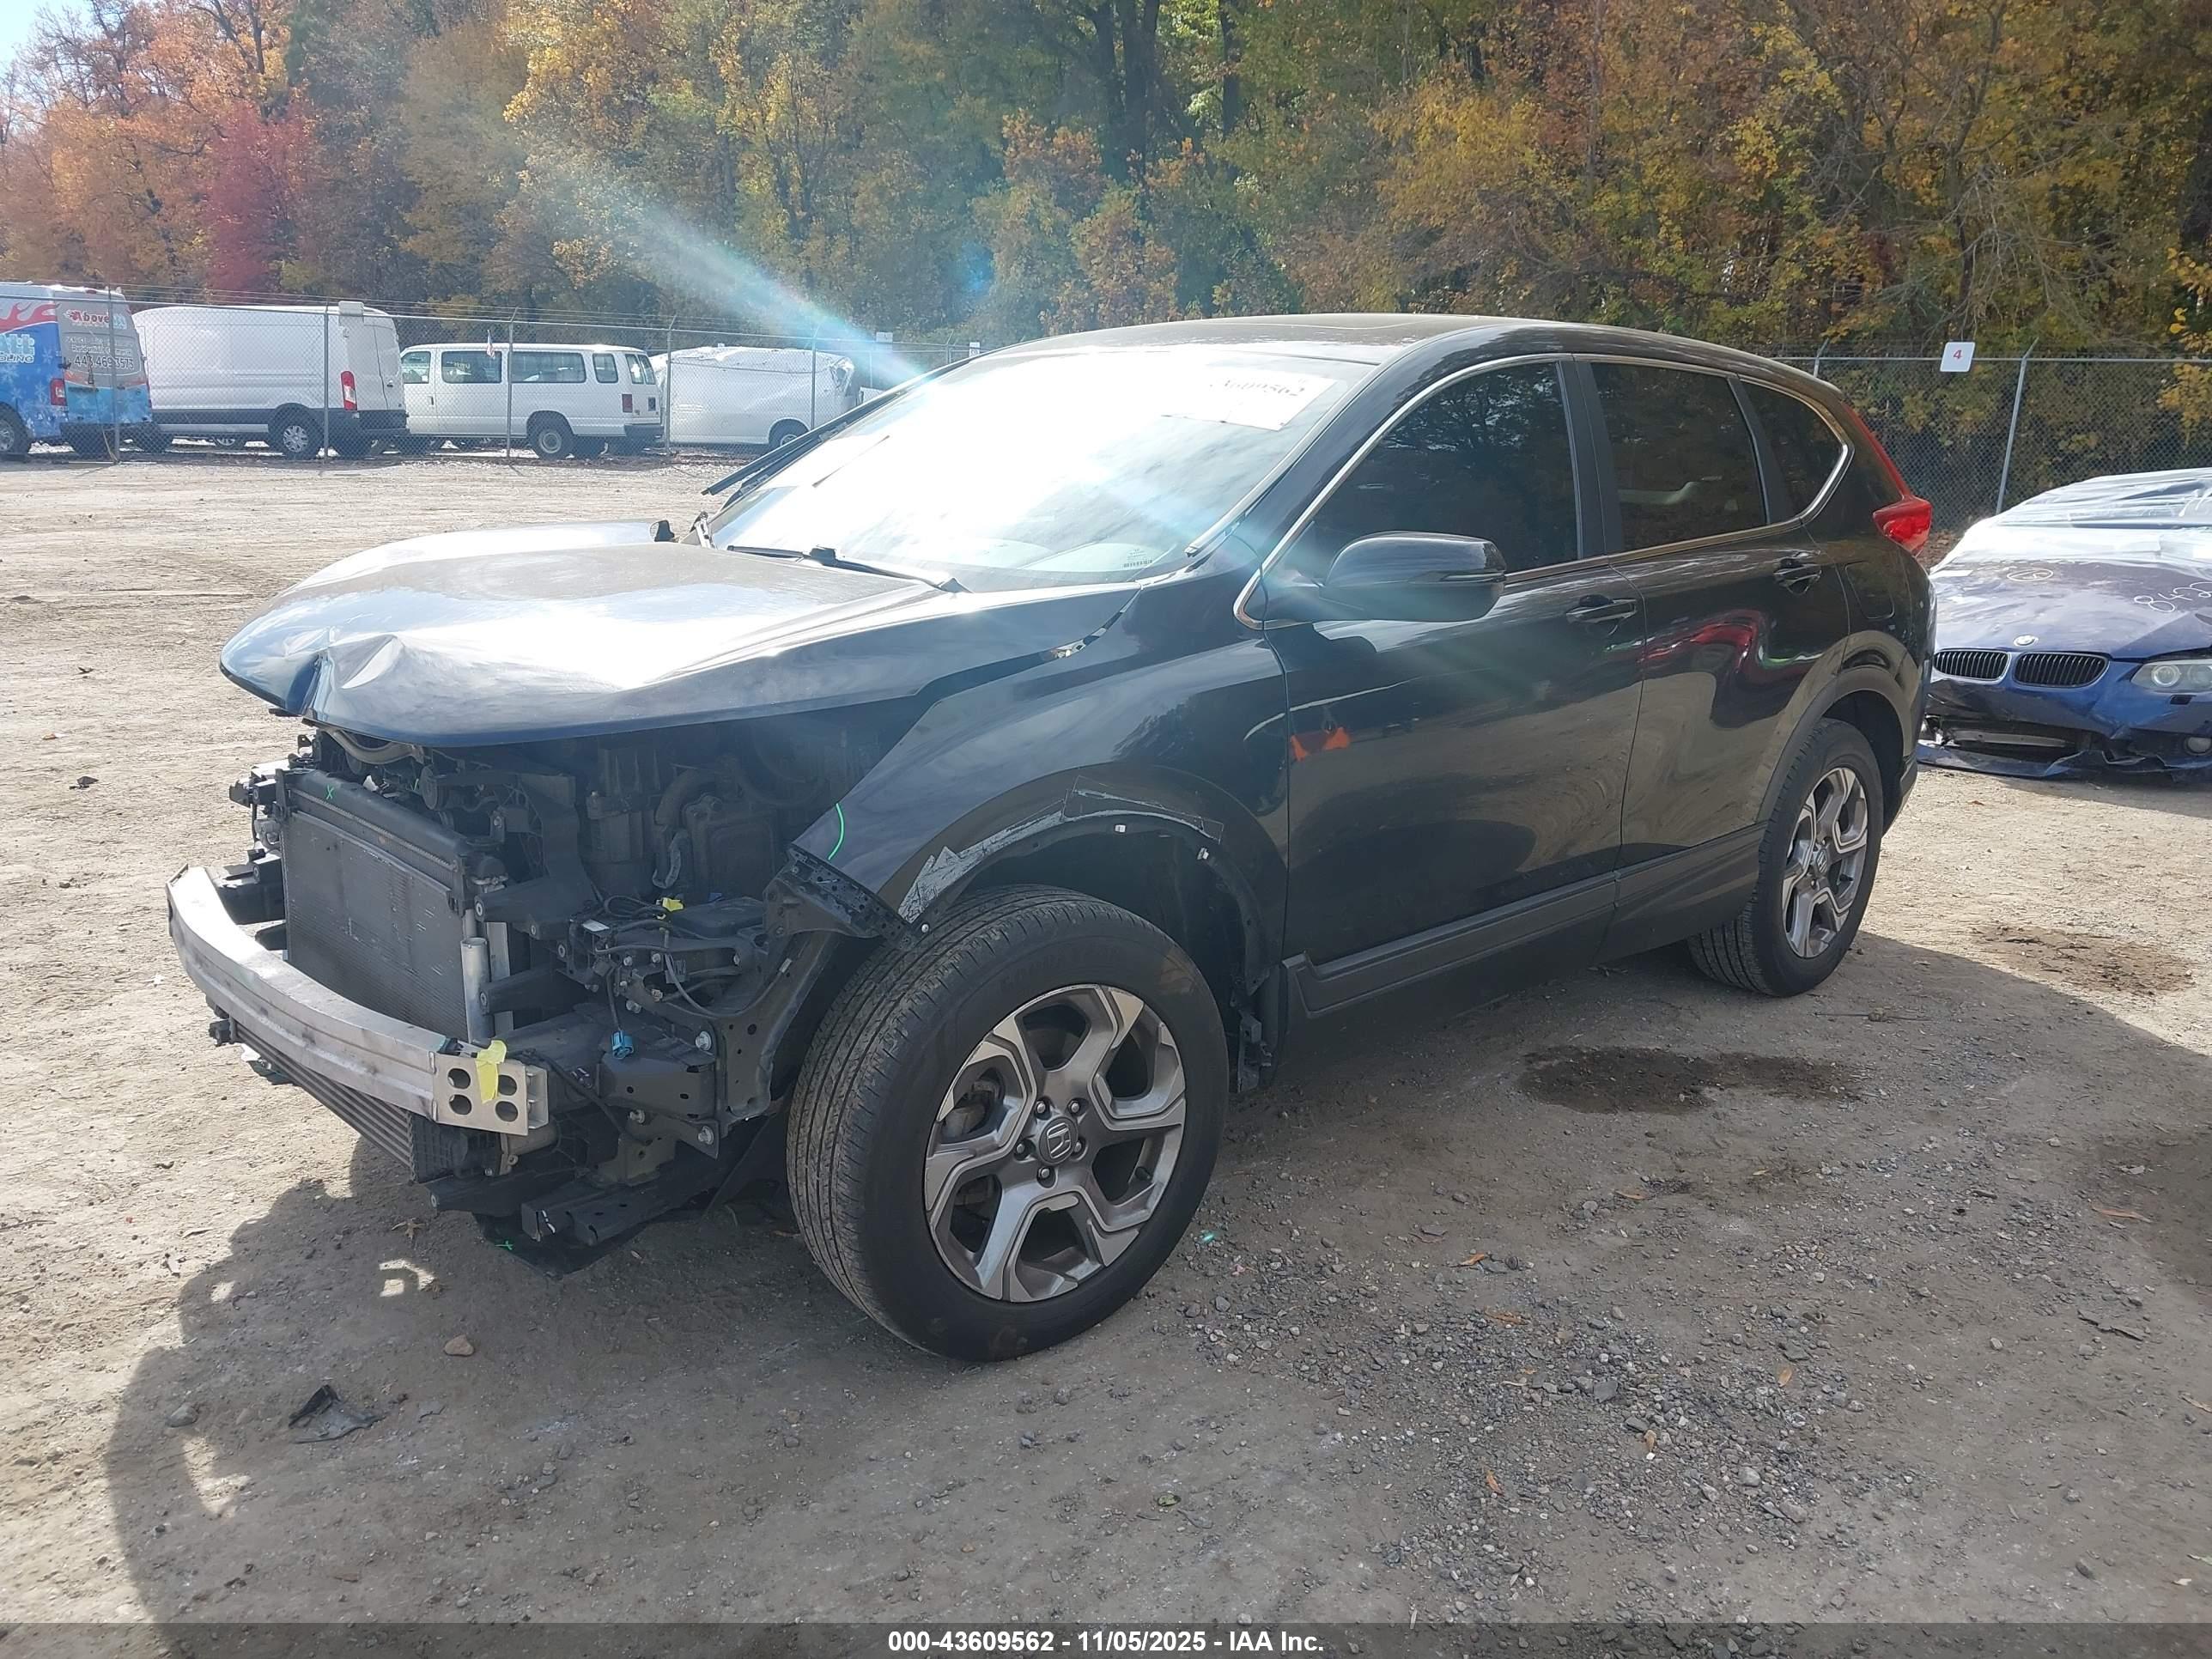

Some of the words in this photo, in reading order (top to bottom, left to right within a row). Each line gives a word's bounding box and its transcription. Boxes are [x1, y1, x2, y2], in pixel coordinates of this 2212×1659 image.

[70, 310, 111, 324] Above
[1953, 349, 1962, 359] 4
[75, 355, 134, 369] 443.4693573
